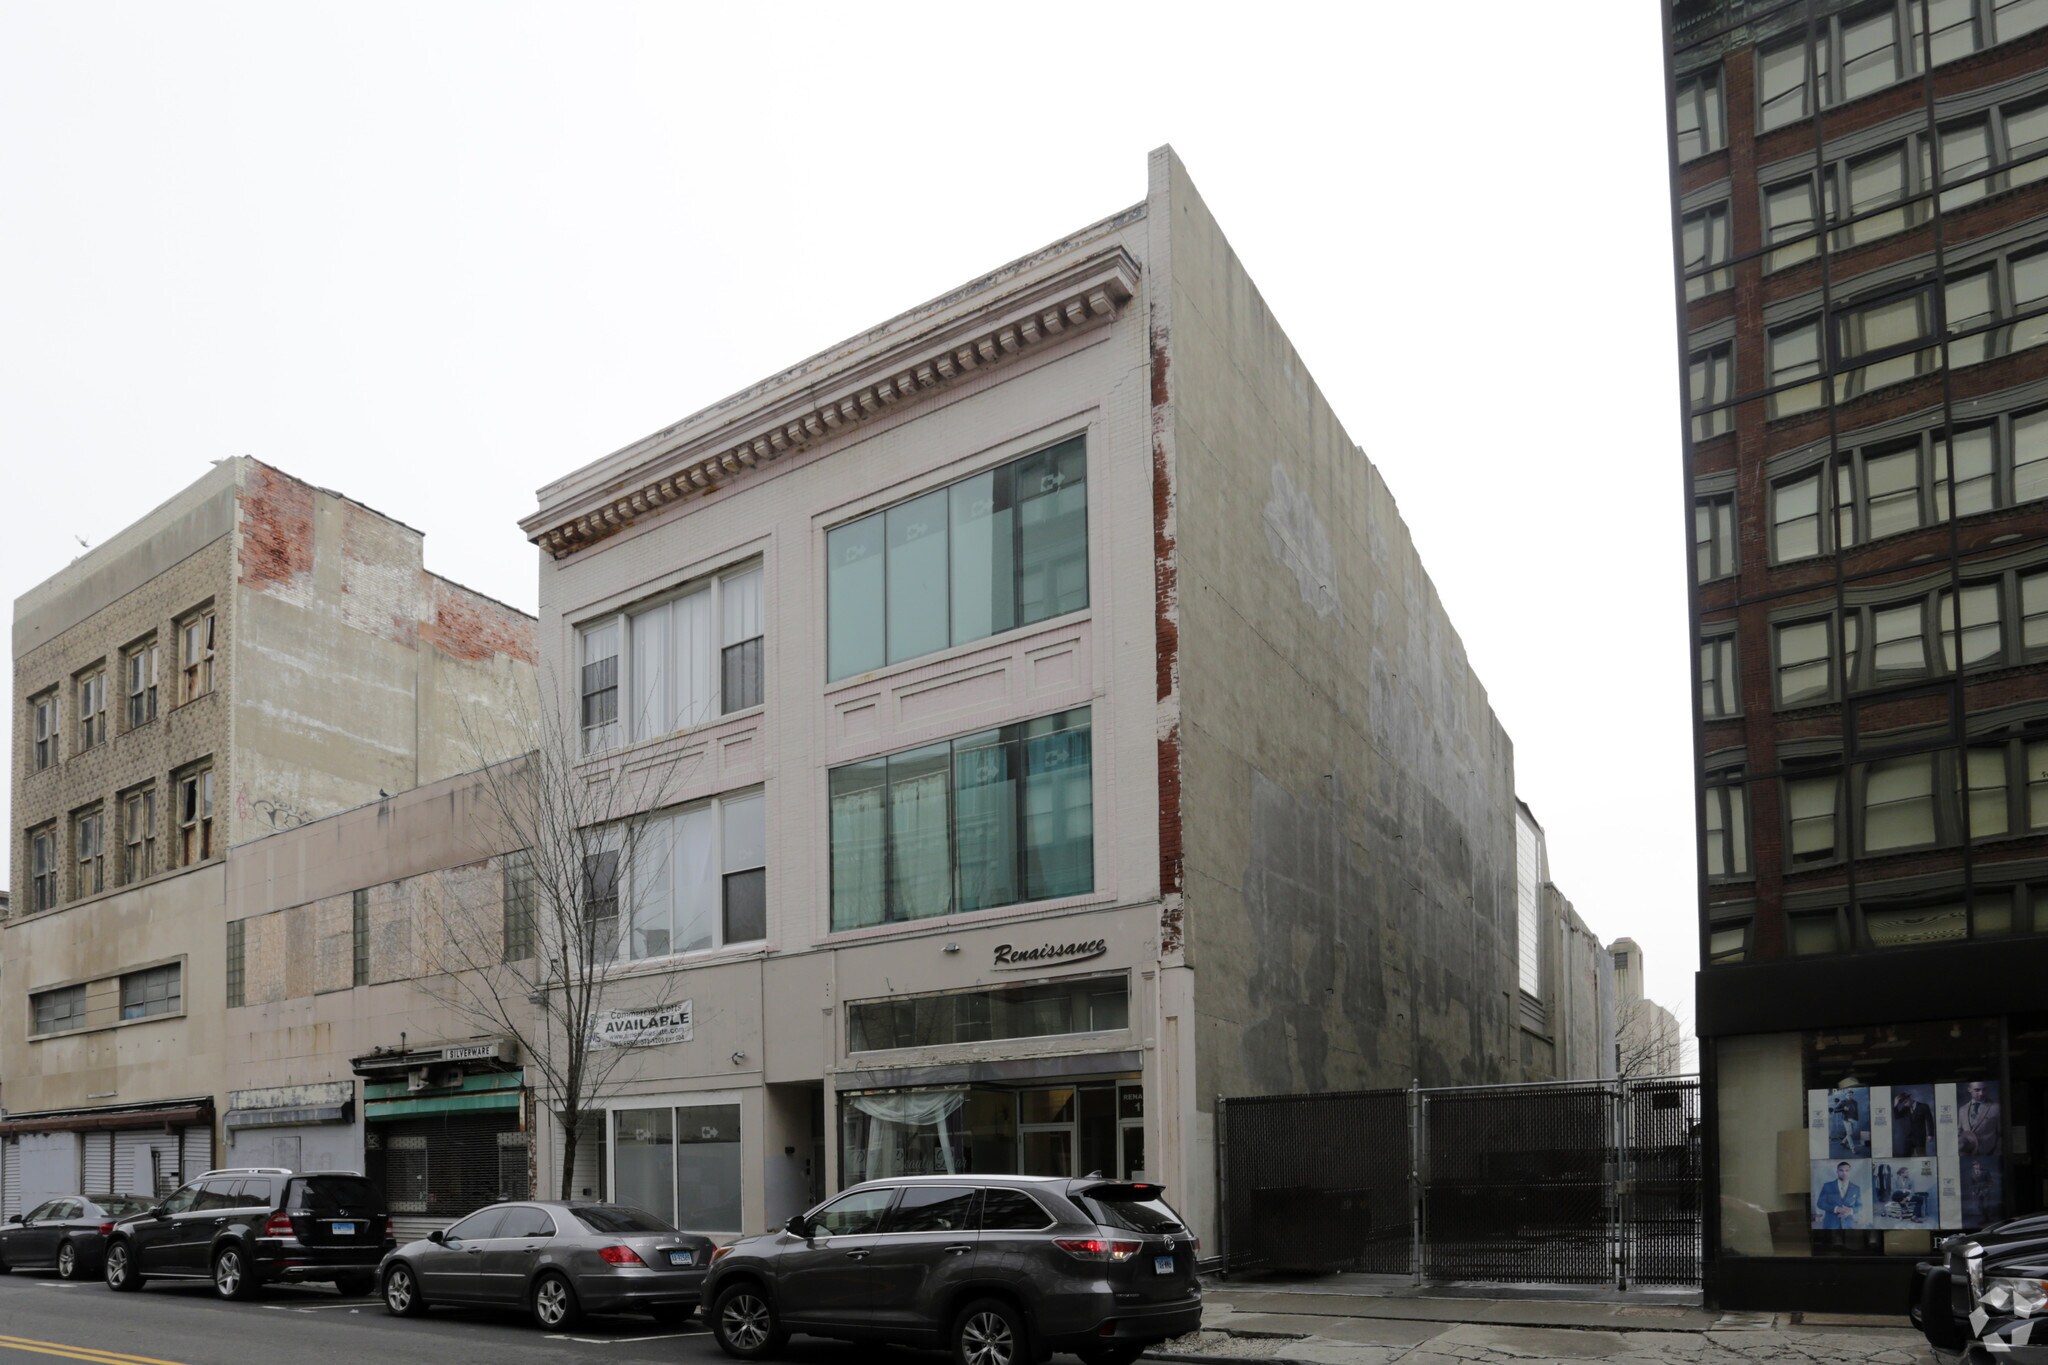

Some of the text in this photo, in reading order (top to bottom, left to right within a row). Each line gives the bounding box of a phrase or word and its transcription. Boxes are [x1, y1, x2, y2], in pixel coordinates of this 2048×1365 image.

[994, 938, 1107, 966] Renaissance
[605, 1012, 689, 1033] AVAILABLE
[450, 1046, 490, 1059] SILVERWARE
